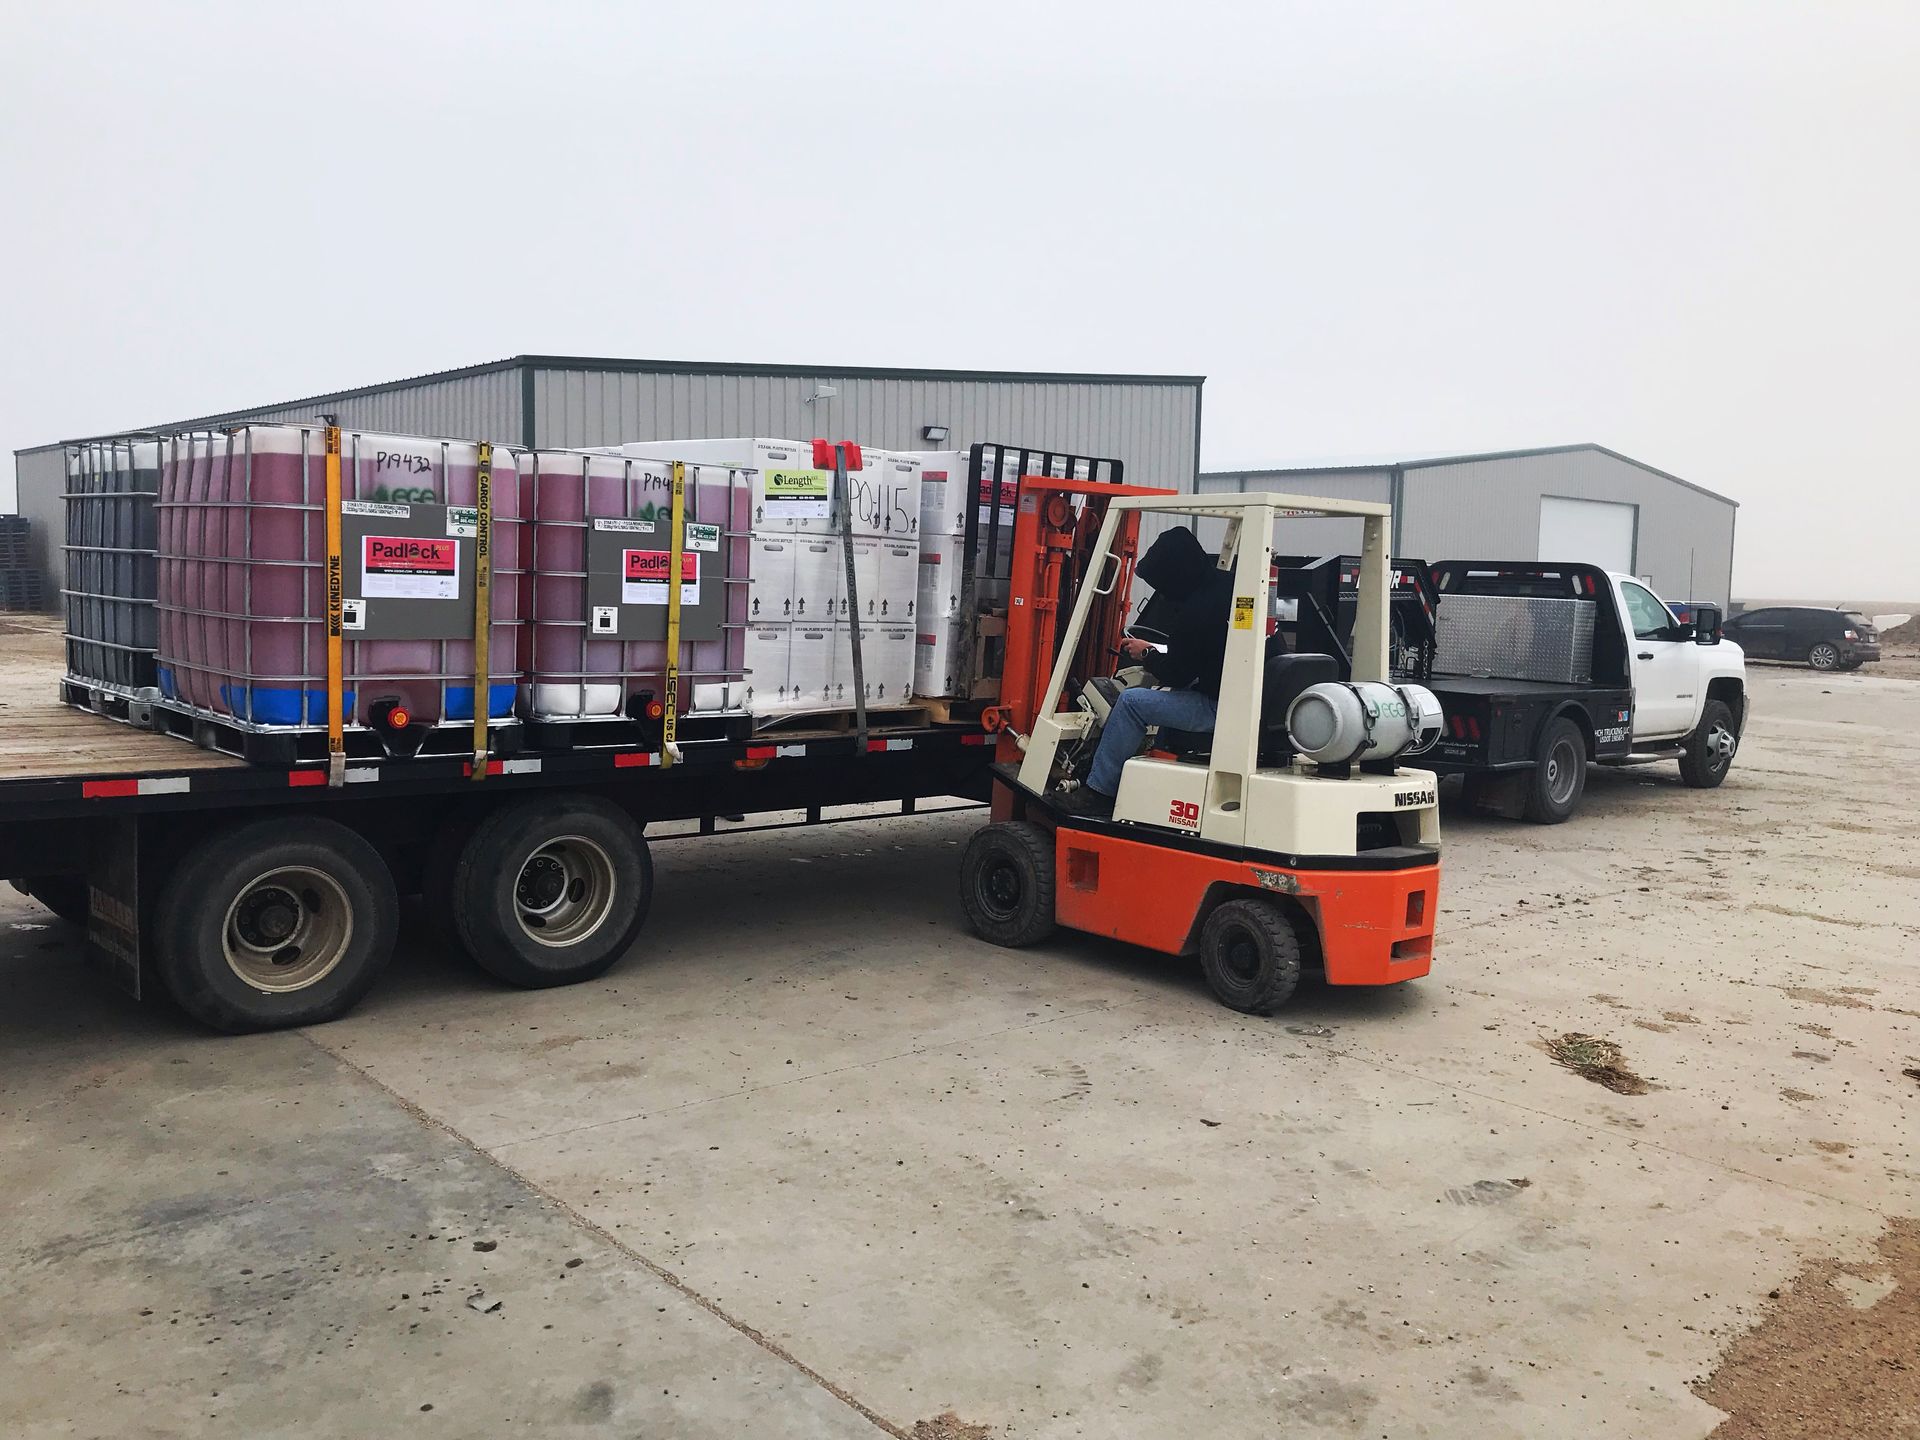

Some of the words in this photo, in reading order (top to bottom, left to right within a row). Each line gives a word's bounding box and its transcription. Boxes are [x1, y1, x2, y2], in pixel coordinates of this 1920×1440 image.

[376, 451, 433, 475] P19432
[783, 475, 813, 488] Length
[480, 475, 489, 510] CARGO
[479, 512, 489, 559] CONTROL
[372, 542, 440, 560] Padlock
[330, 556, 340, 611] KINEDYNE
[666, 718, 674, 731] US
[1604, 726, 1623, 736] TRUCKING
[1394, 790, 1434, 807] NISSAN
[1170, 800, 1200, 820] 30
[1168, 816, 1198, 828] NISSAN
